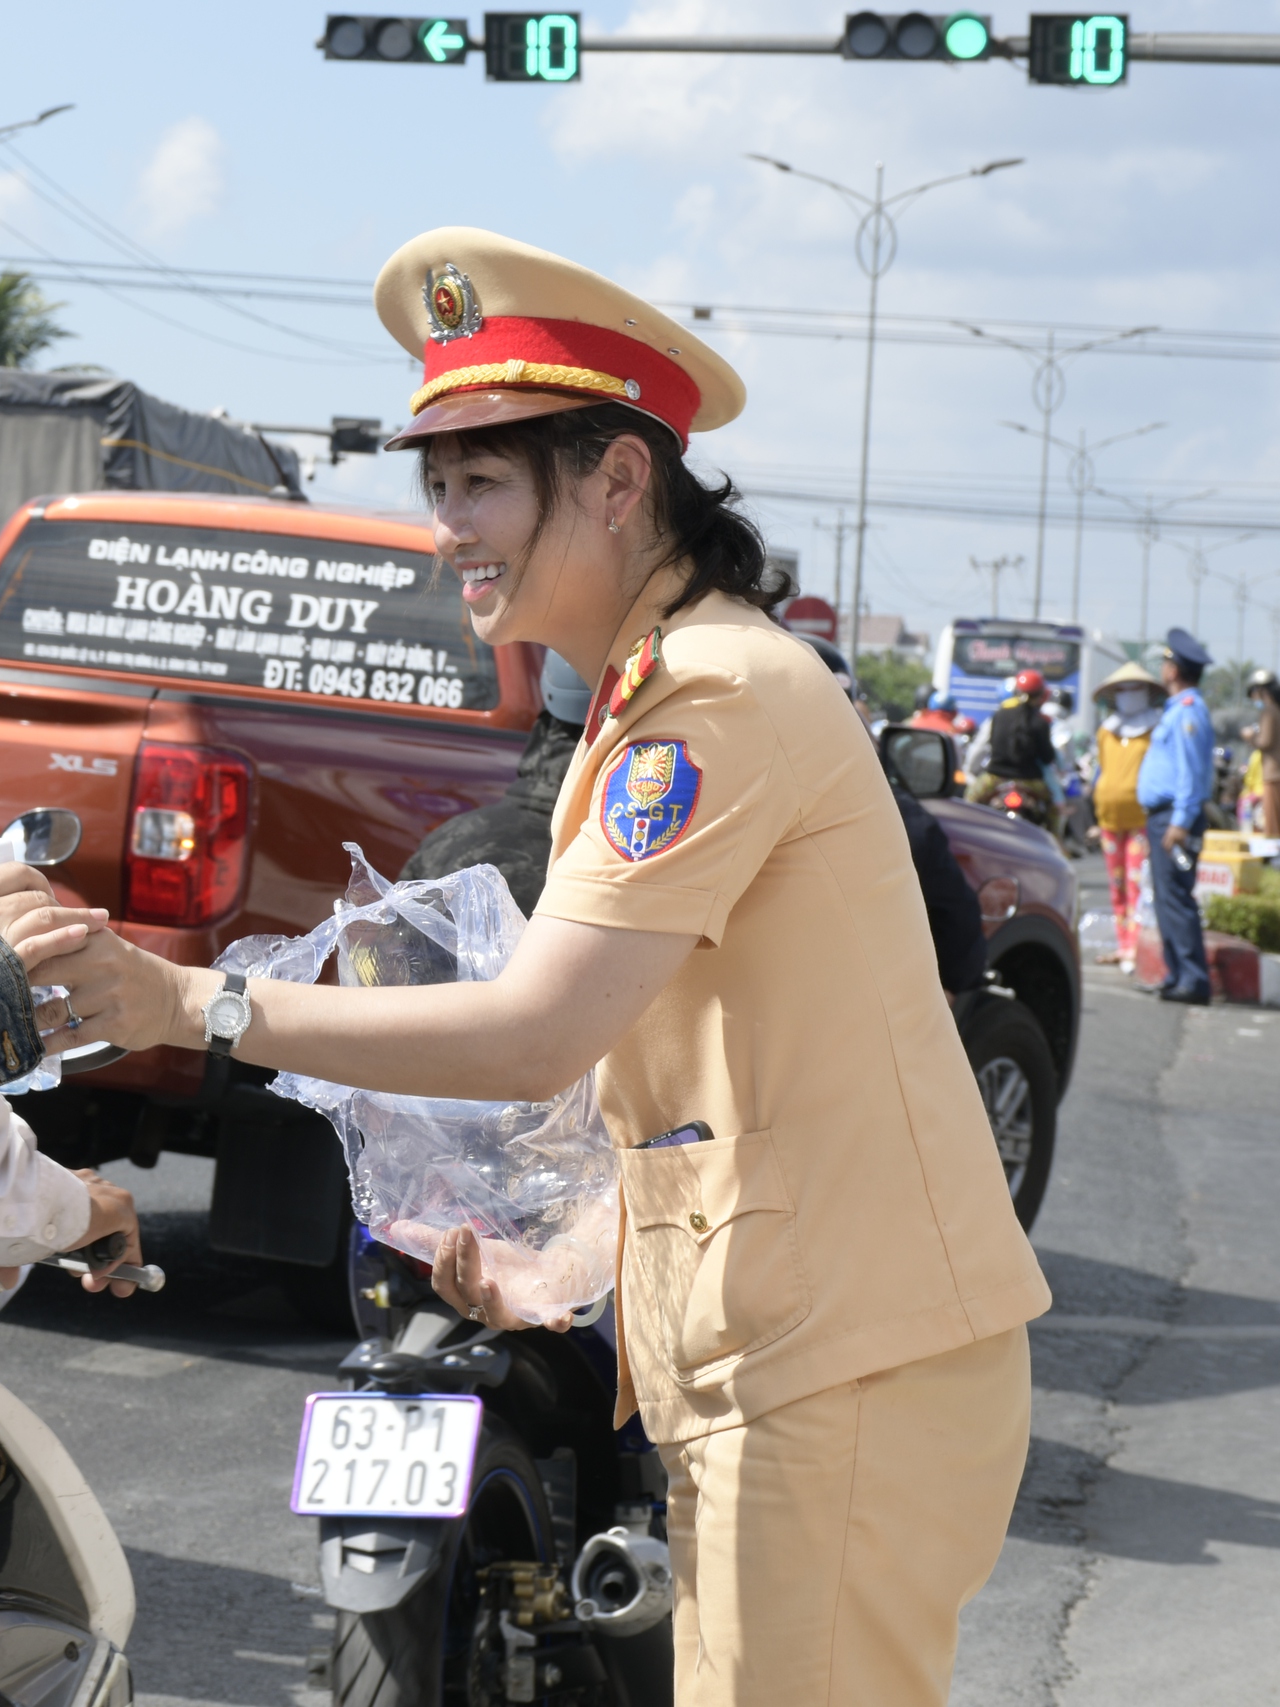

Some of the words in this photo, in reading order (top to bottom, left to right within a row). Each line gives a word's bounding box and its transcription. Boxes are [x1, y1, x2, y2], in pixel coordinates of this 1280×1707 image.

[526, 14, 577, 81] 10
[1070, 16, 1124, 83] 10
[88, 537, 151, 566] ĐIỆN
[155, 545, 229, 571] LẠNH
[231, 549, 309, 579] CÔNG
[314, 560, 416, 592] NGHIỆP
[112, 571, 273, 625] HOÀNG
[285, 592, 379, 634] DUY
[263, 658, 303, 692] ĐT:
[308, 663, 367, 698] 0943
[370, 669, 415, 703] 832
[417, 675, 464, 709] 066
[47, 752, 119, 777] XLS
[331, 1405, 447, 1452] 63-P1
[306, 1459, 458, 1507] 217.03
